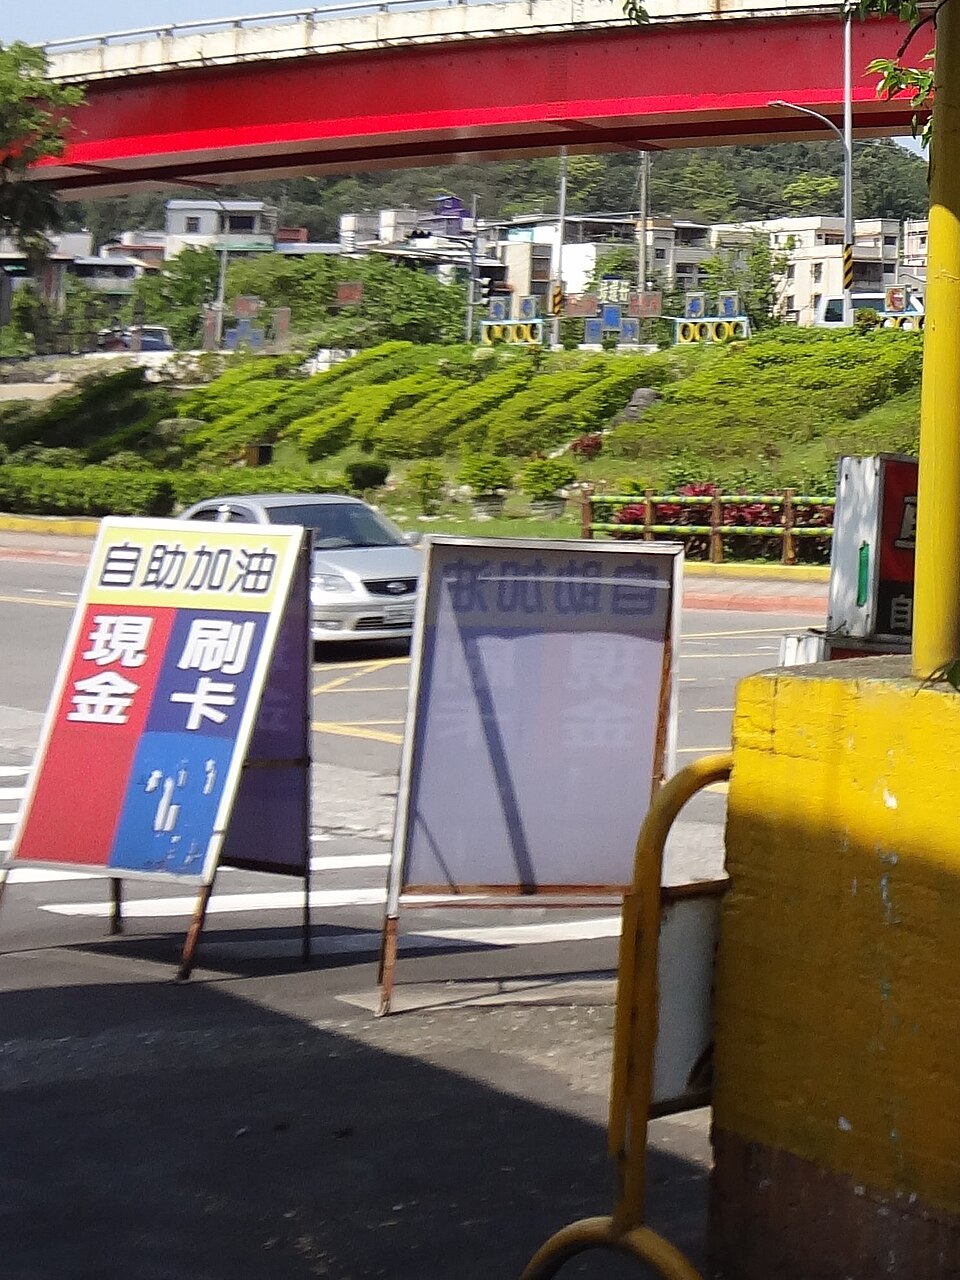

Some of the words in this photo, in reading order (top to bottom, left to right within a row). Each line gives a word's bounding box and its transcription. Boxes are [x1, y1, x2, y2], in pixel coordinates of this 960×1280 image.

[99, 540, 279, 594] 自助加油
[66, 615, 153, 725] 現金
[170, 618, 254, 730] 刷卡
